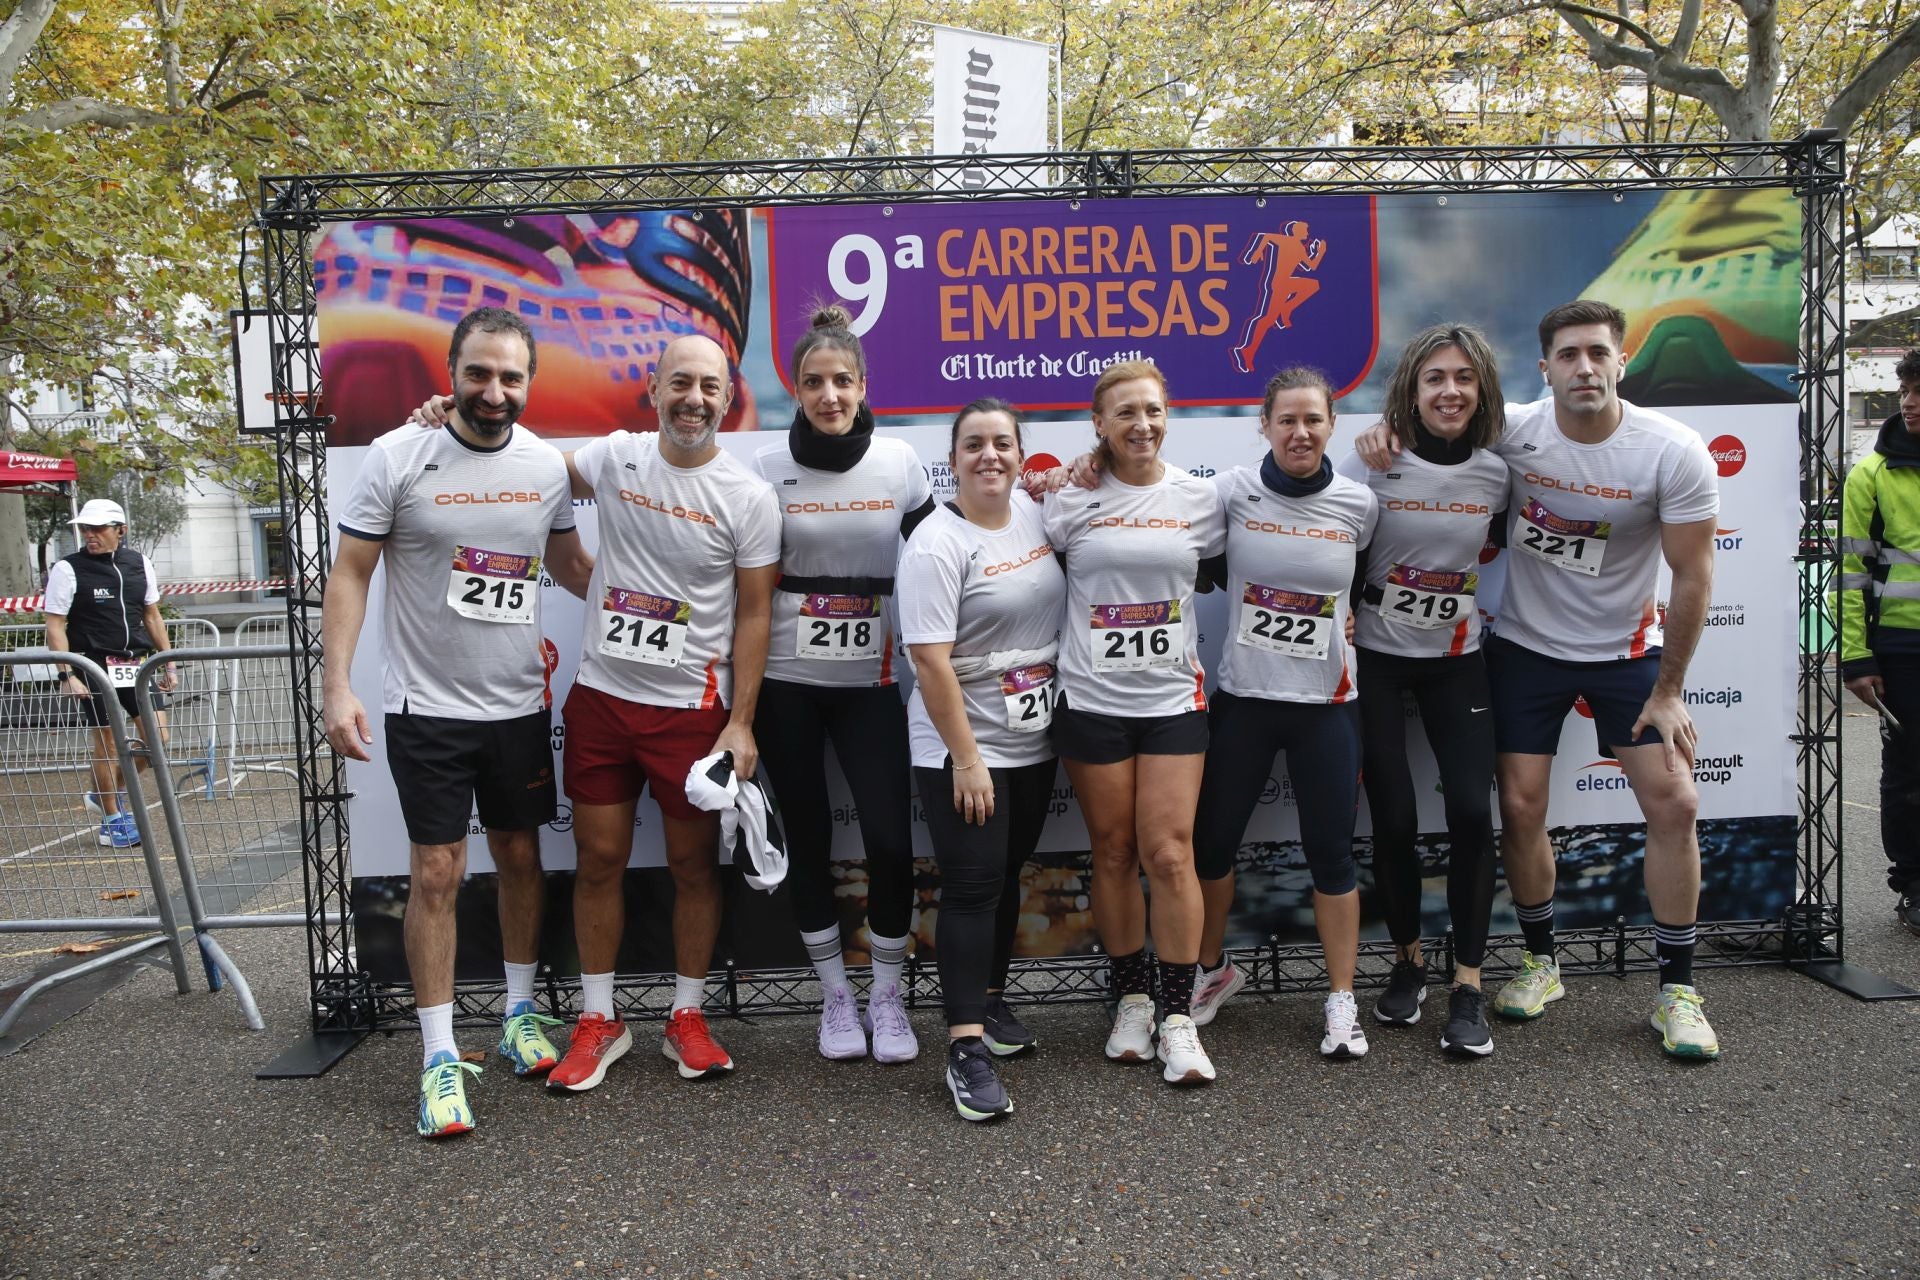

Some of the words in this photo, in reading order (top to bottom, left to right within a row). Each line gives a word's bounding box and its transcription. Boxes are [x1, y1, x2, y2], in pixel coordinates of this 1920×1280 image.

[936, 225, 1157, 278] CARRERA
[1170, 224, 1230, 272] DE
[939, 278, 1231, 342] EMPRESAS
[940, 353, 972, 381] El
[973, 353, 1037, 380] Norte
[1038, 354, 1063, 377] de
[435, 492, 542, 505] COLLOSA
[1524, 473, 1633, 500] COLLOSA
[619, 489, 718, 528] COLLOSA
[786, 500, 896, 514] COLLOSA
[1386, 500, 1489, 515] COLLOSA
[1088, 517, 1191, 529] COLLOSA
[1245, 520, 1356, 543] COLLOSA
[1523, 526, 1586, 560] 221
[984, 543, 1054, 577] COLLOSA
[461, 577, 525, 610] 215
[1393, 589, 1459, 620] 219
[606, 615, 669, 652] 214
[809, 620, 871, 648] 218
[1104, 628, 1170, 659] 216
[1251, 610, 1316, 646] 222
[1691, 769, 1732, 785] roup
